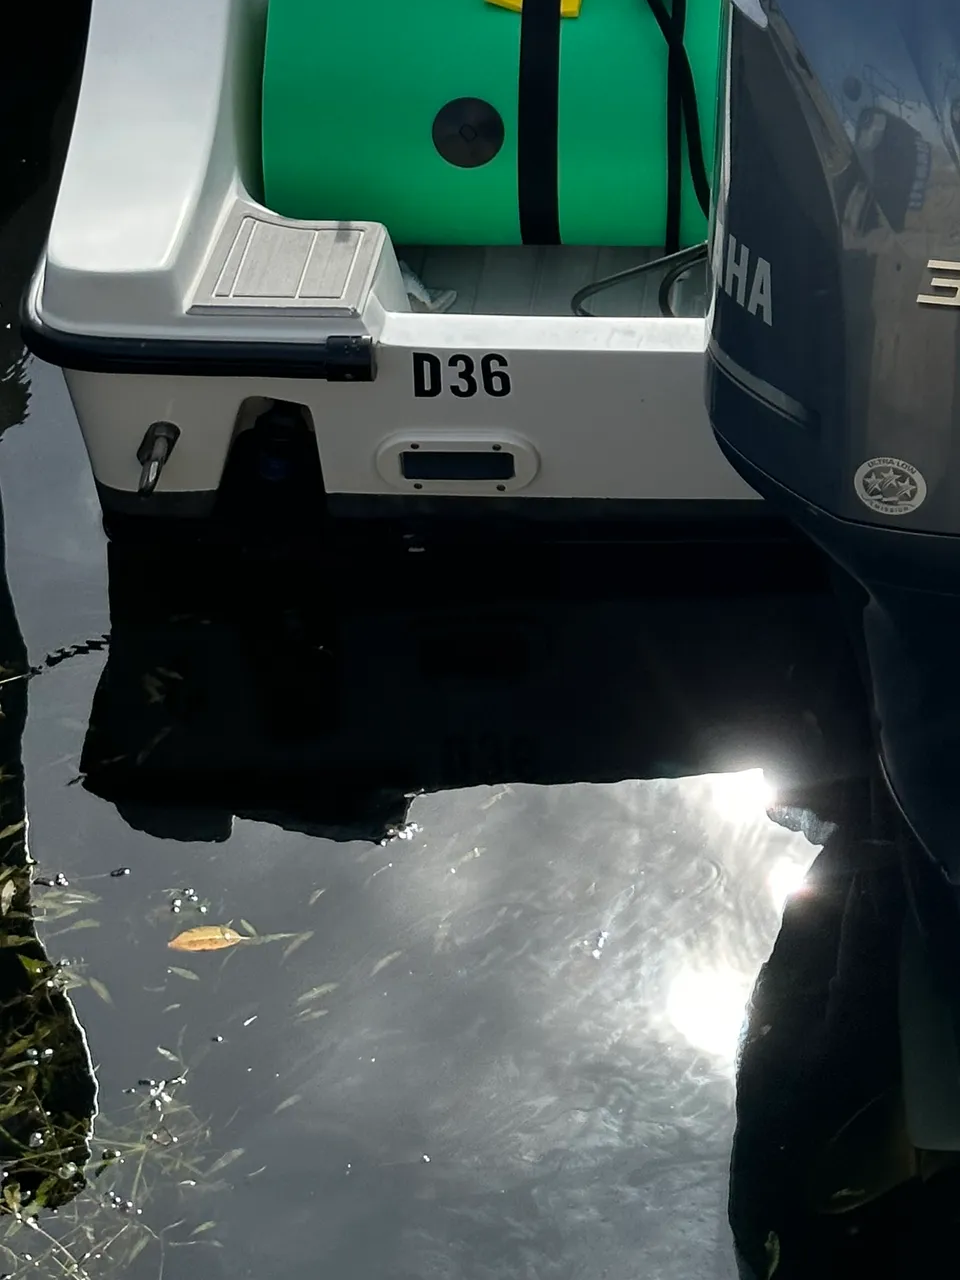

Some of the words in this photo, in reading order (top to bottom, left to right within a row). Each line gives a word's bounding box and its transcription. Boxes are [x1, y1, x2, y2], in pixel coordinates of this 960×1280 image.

[412, 352, 511, 398] D36
[867, 458, 895, 469] ULTRA
[896, 461, 917, 475] LOW
